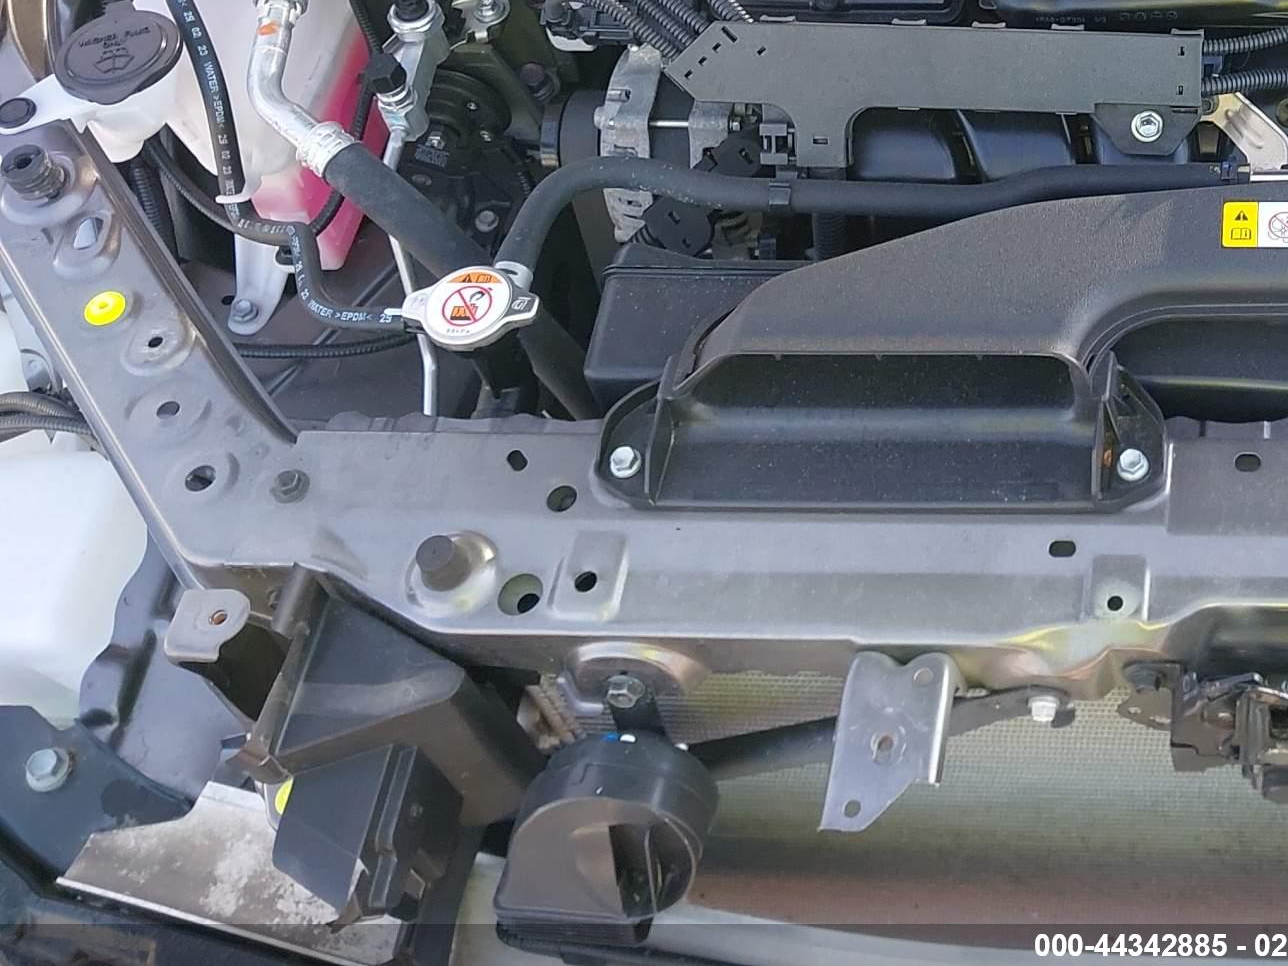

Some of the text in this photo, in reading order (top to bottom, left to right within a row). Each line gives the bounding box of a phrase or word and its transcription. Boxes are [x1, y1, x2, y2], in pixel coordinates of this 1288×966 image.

[203, 60, 220, 94] WATER
[307, 299, 333, 319] WATER
[334, 312, 374, 324] >EPDM<
[378, 312, 392, 324] 25
